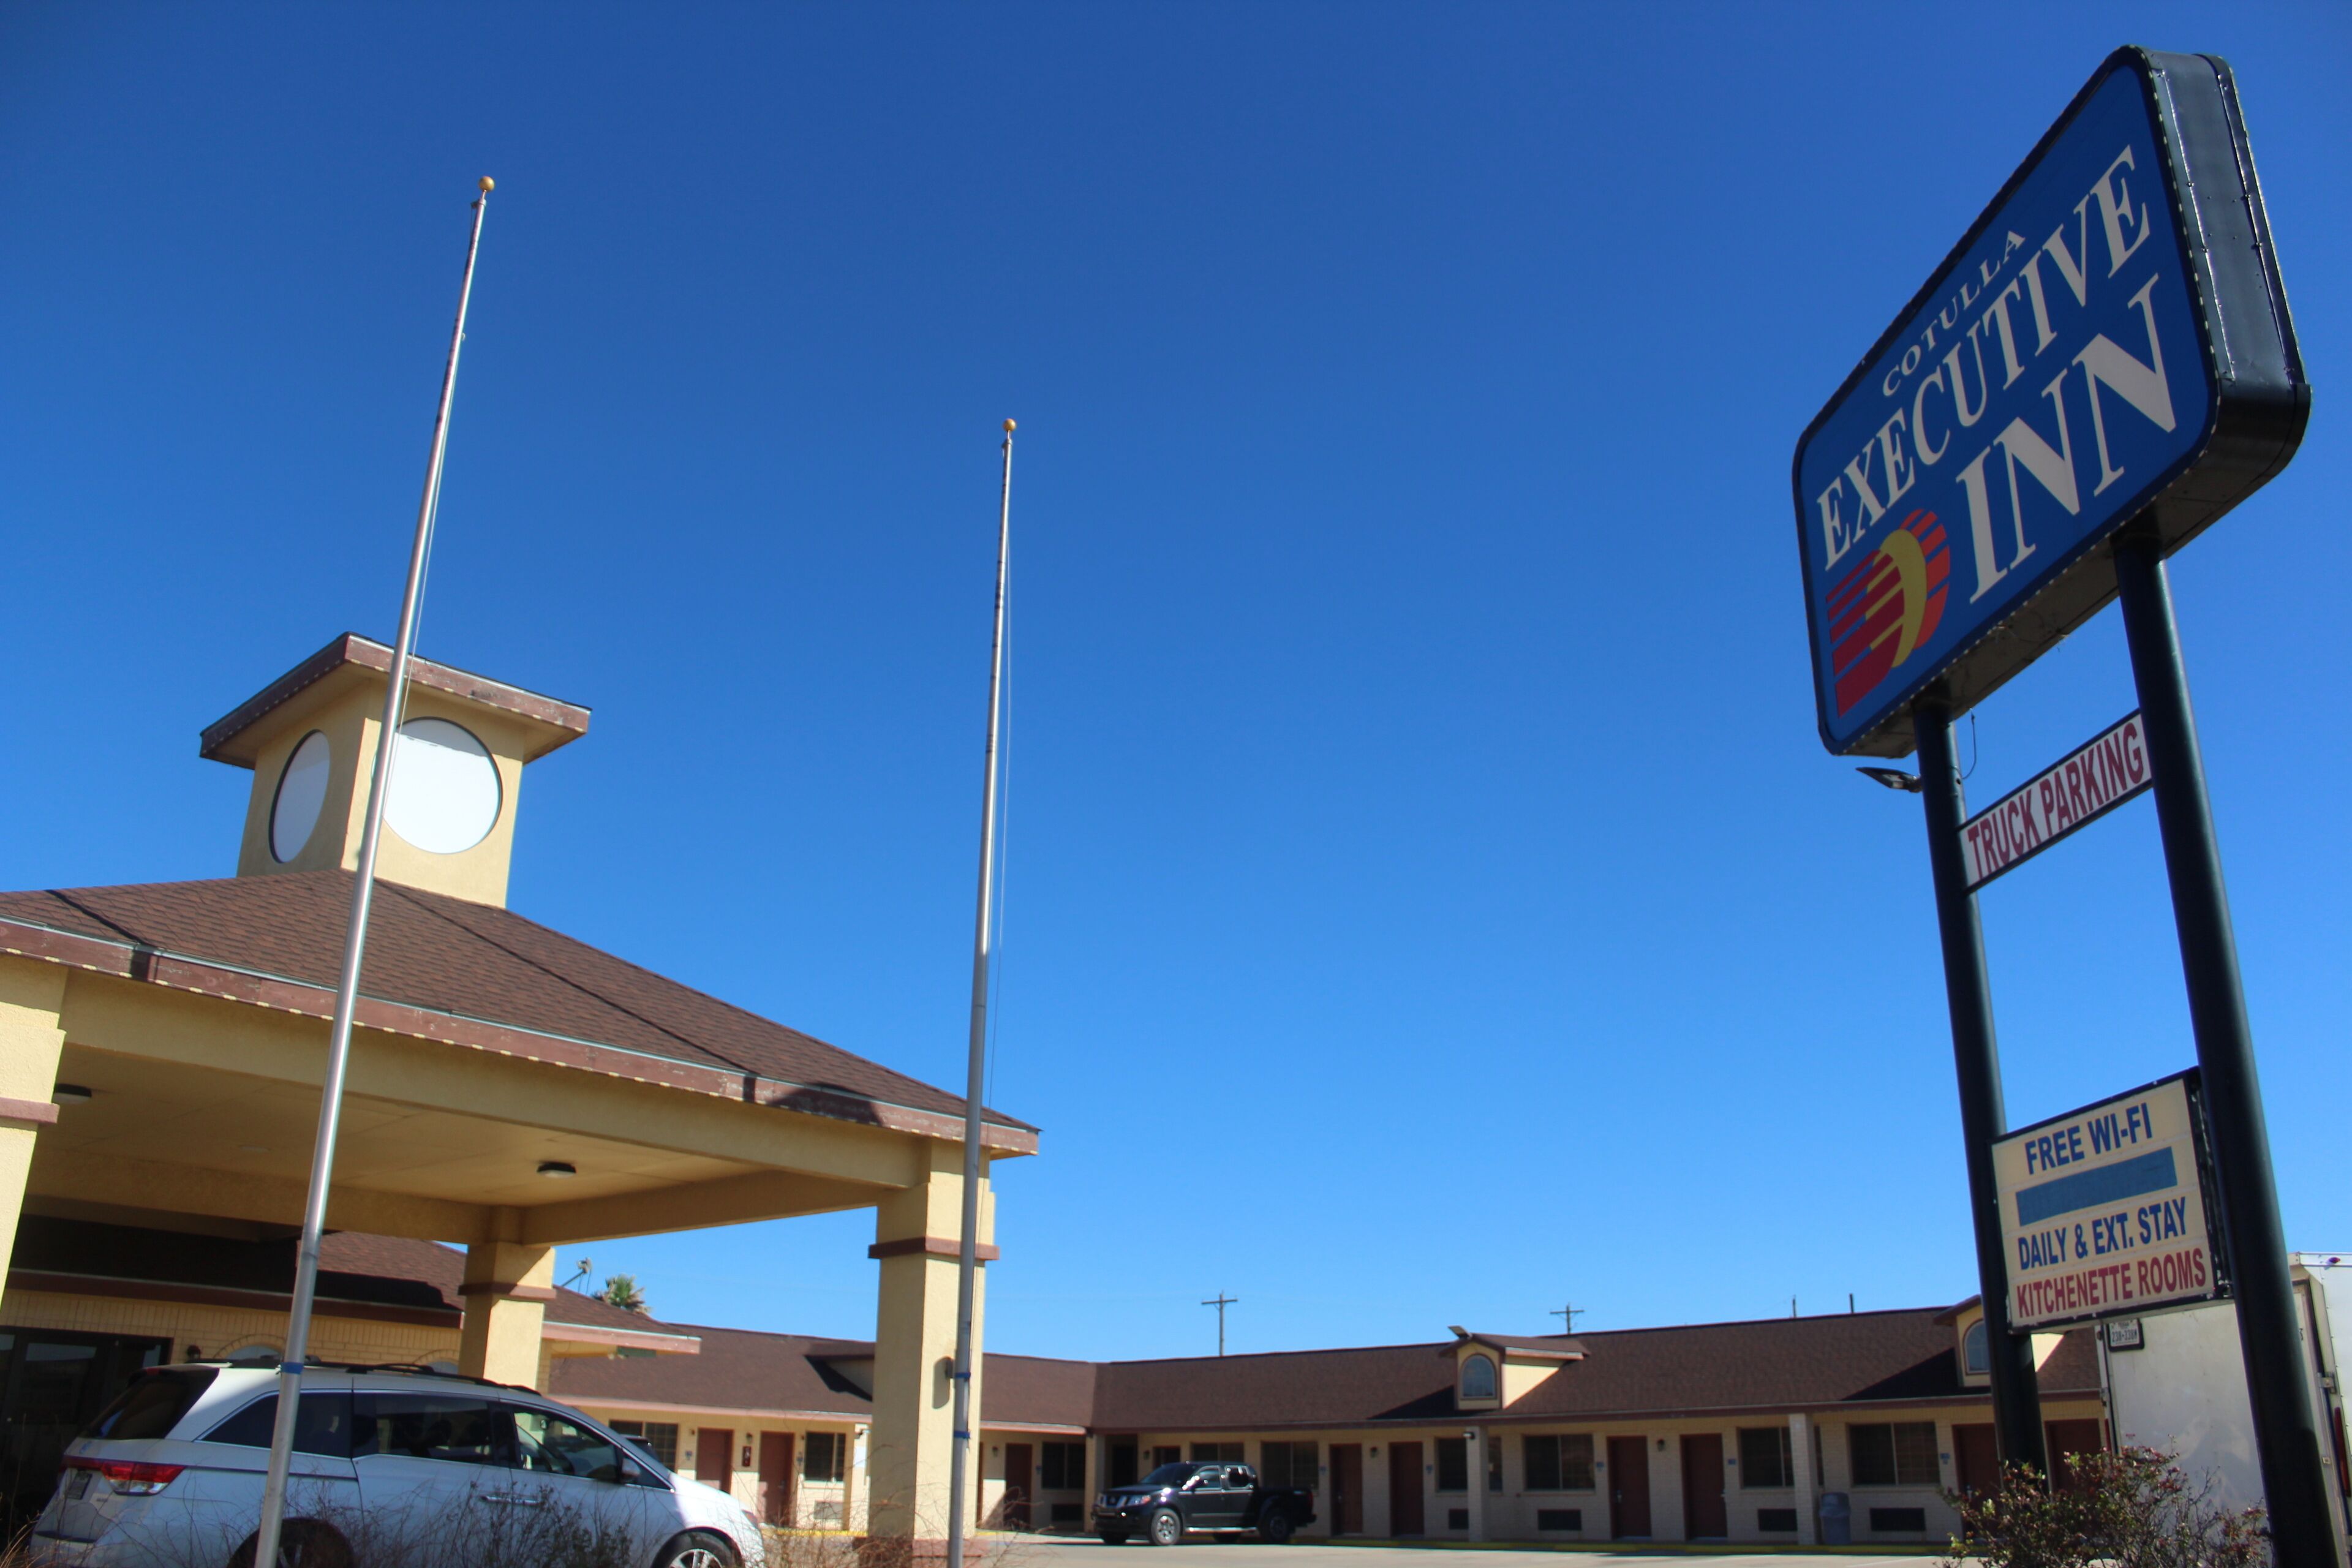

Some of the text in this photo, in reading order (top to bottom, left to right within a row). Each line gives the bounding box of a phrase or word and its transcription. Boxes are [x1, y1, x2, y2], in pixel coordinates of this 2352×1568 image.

[1817, 145, 2150, 571] EXECUTIVE
[1882, 230, 2026, 397] COTULLA
[1956, 273, 2177, 604] INN
[1967, 722, 2144, 880] TRUCK PARKING
[2024, 1102, 2153, 1175] FREE WI-FI
[2016, 1247, 2206, 1318] KITCHENETTE ROOMS
[2018, 1196, 2187, 1270] DAILY & EXT. STAY
